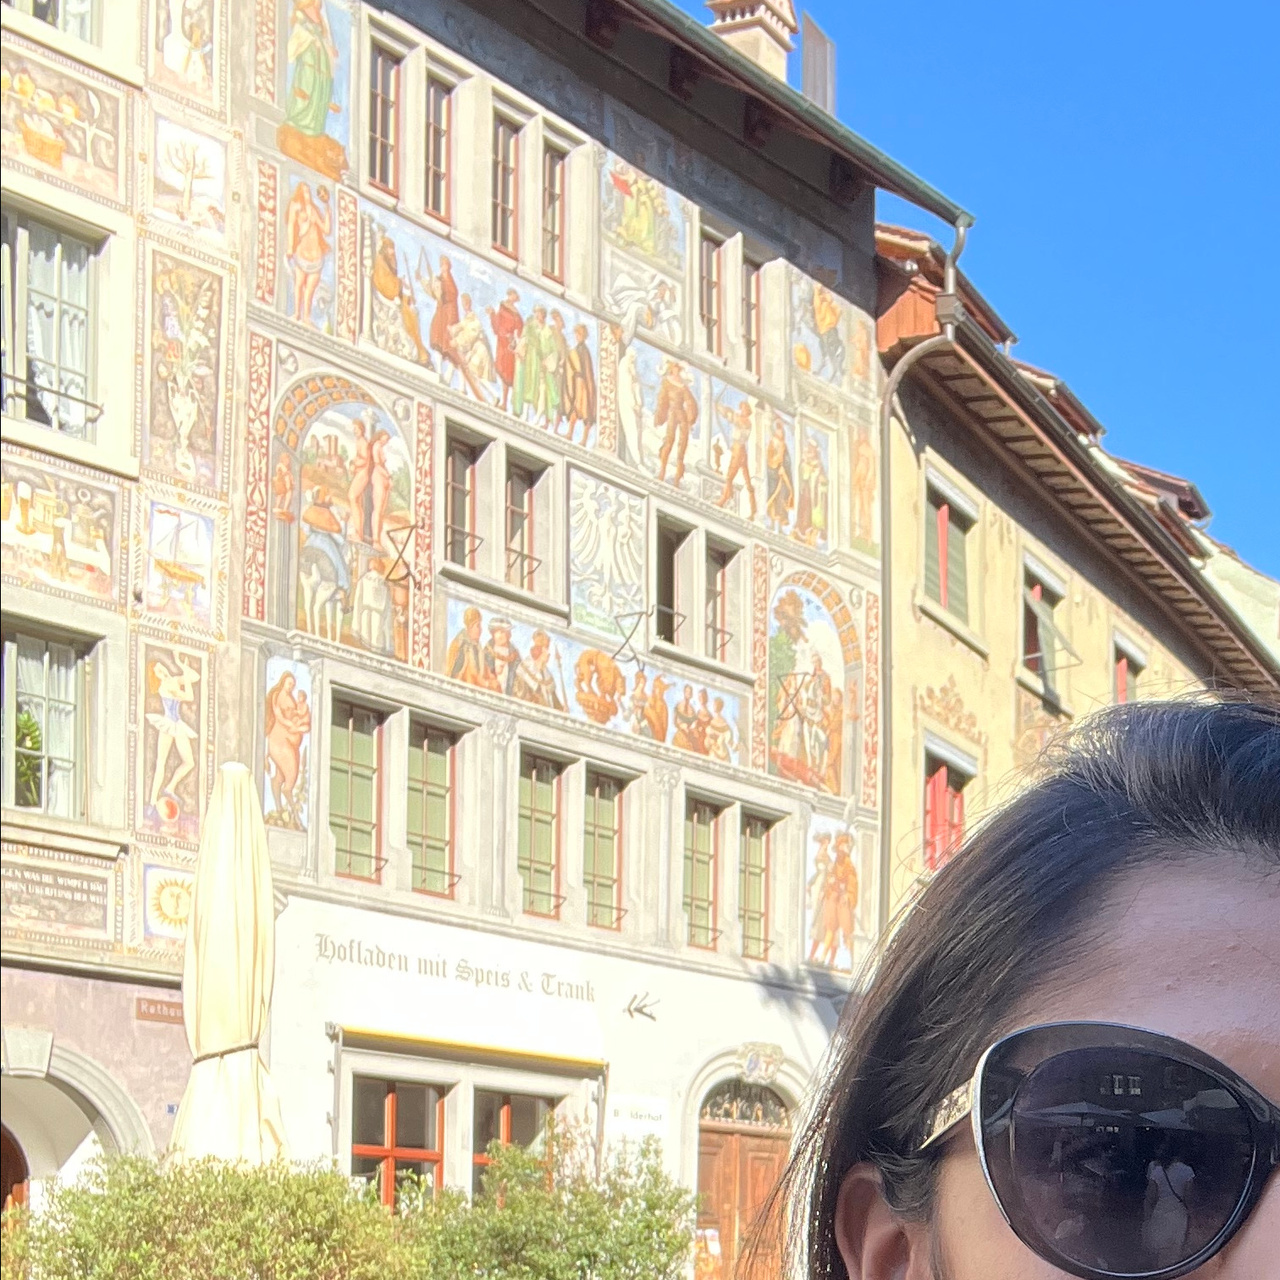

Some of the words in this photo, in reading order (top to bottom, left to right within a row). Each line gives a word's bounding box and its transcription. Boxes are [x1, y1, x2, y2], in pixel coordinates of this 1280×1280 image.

[315, 933, 408, 973] Hofladen
[418, 954, 447, 979] mit
[455, 958, 511, 988] Speis
[518, 971, 533, 993] &
[541, 972, 595, 1003] Trank
[140, 999, 183, 1018] Rathau
